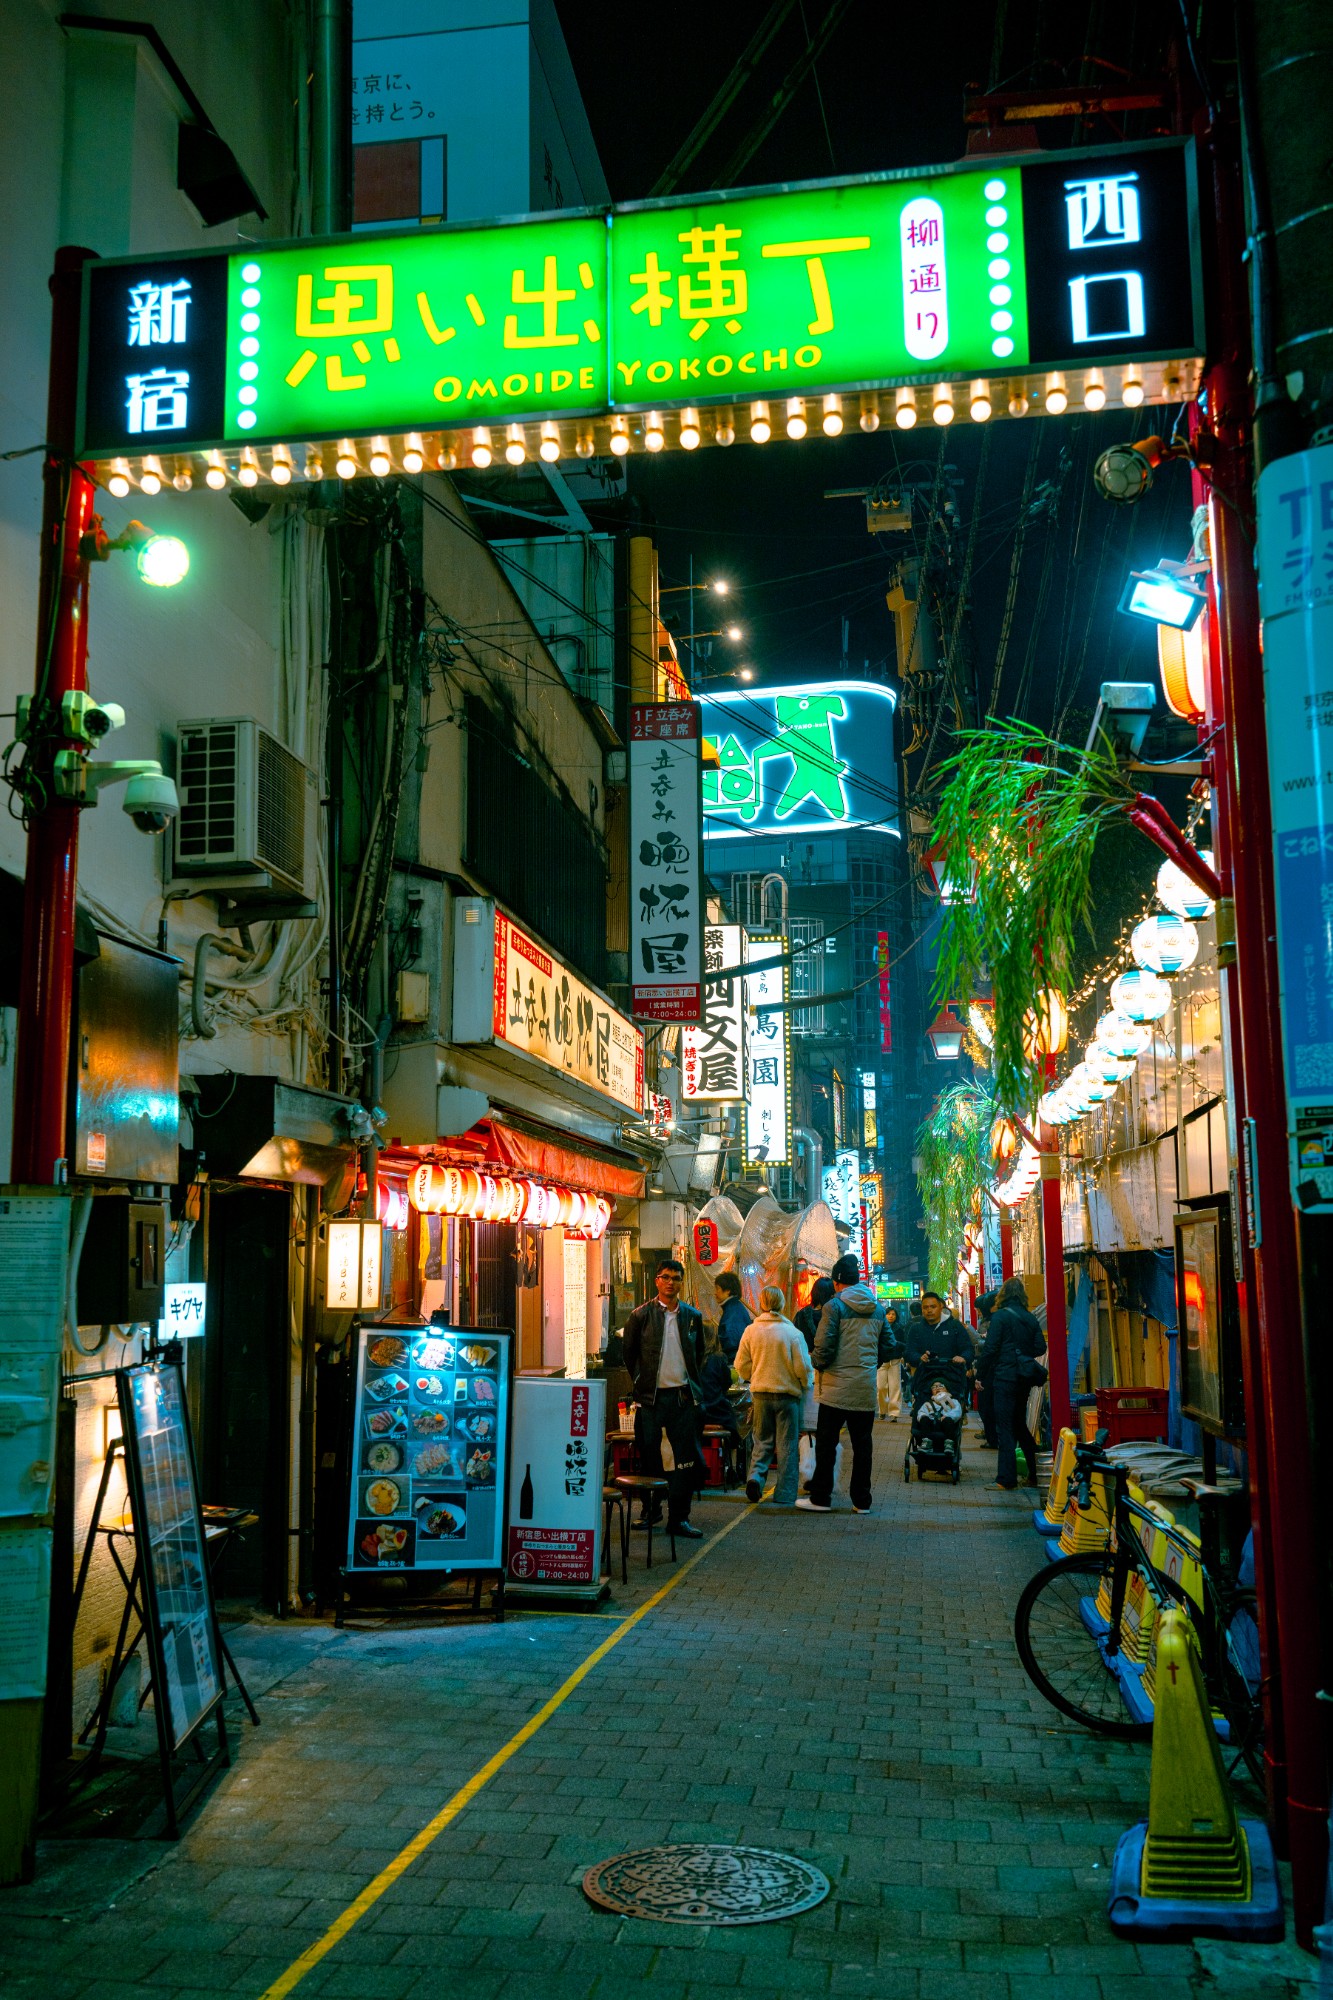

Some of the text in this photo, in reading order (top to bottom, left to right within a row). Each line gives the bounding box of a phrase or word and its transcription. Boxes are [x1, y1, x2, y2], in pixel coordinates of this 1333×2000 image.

[1064, 172, 1145, 345] 西口
[906, 216, 942, 340] 柳通り
[285, 222, 871, 392] 思い出横丁
[126, 278, 193, 434] 新宿
[433, 344, 823, 404] OMOIDE YOKOCHO
[656, 707, 693, 721] 立呑み
[659, 723, 689, 737] 座席
[637, 988, 695, 998] 新宿思い出横丁店
[761, 1109, 772, 1146] 刺し身
[418, 1169, 427, 1203] キリンビール
[698, 1224, 712, 1261] 四文屋
[573, 1390, 587, 1432] 立呑み
[517, 1530, 587, 1542] 新宿思い出横丁店
